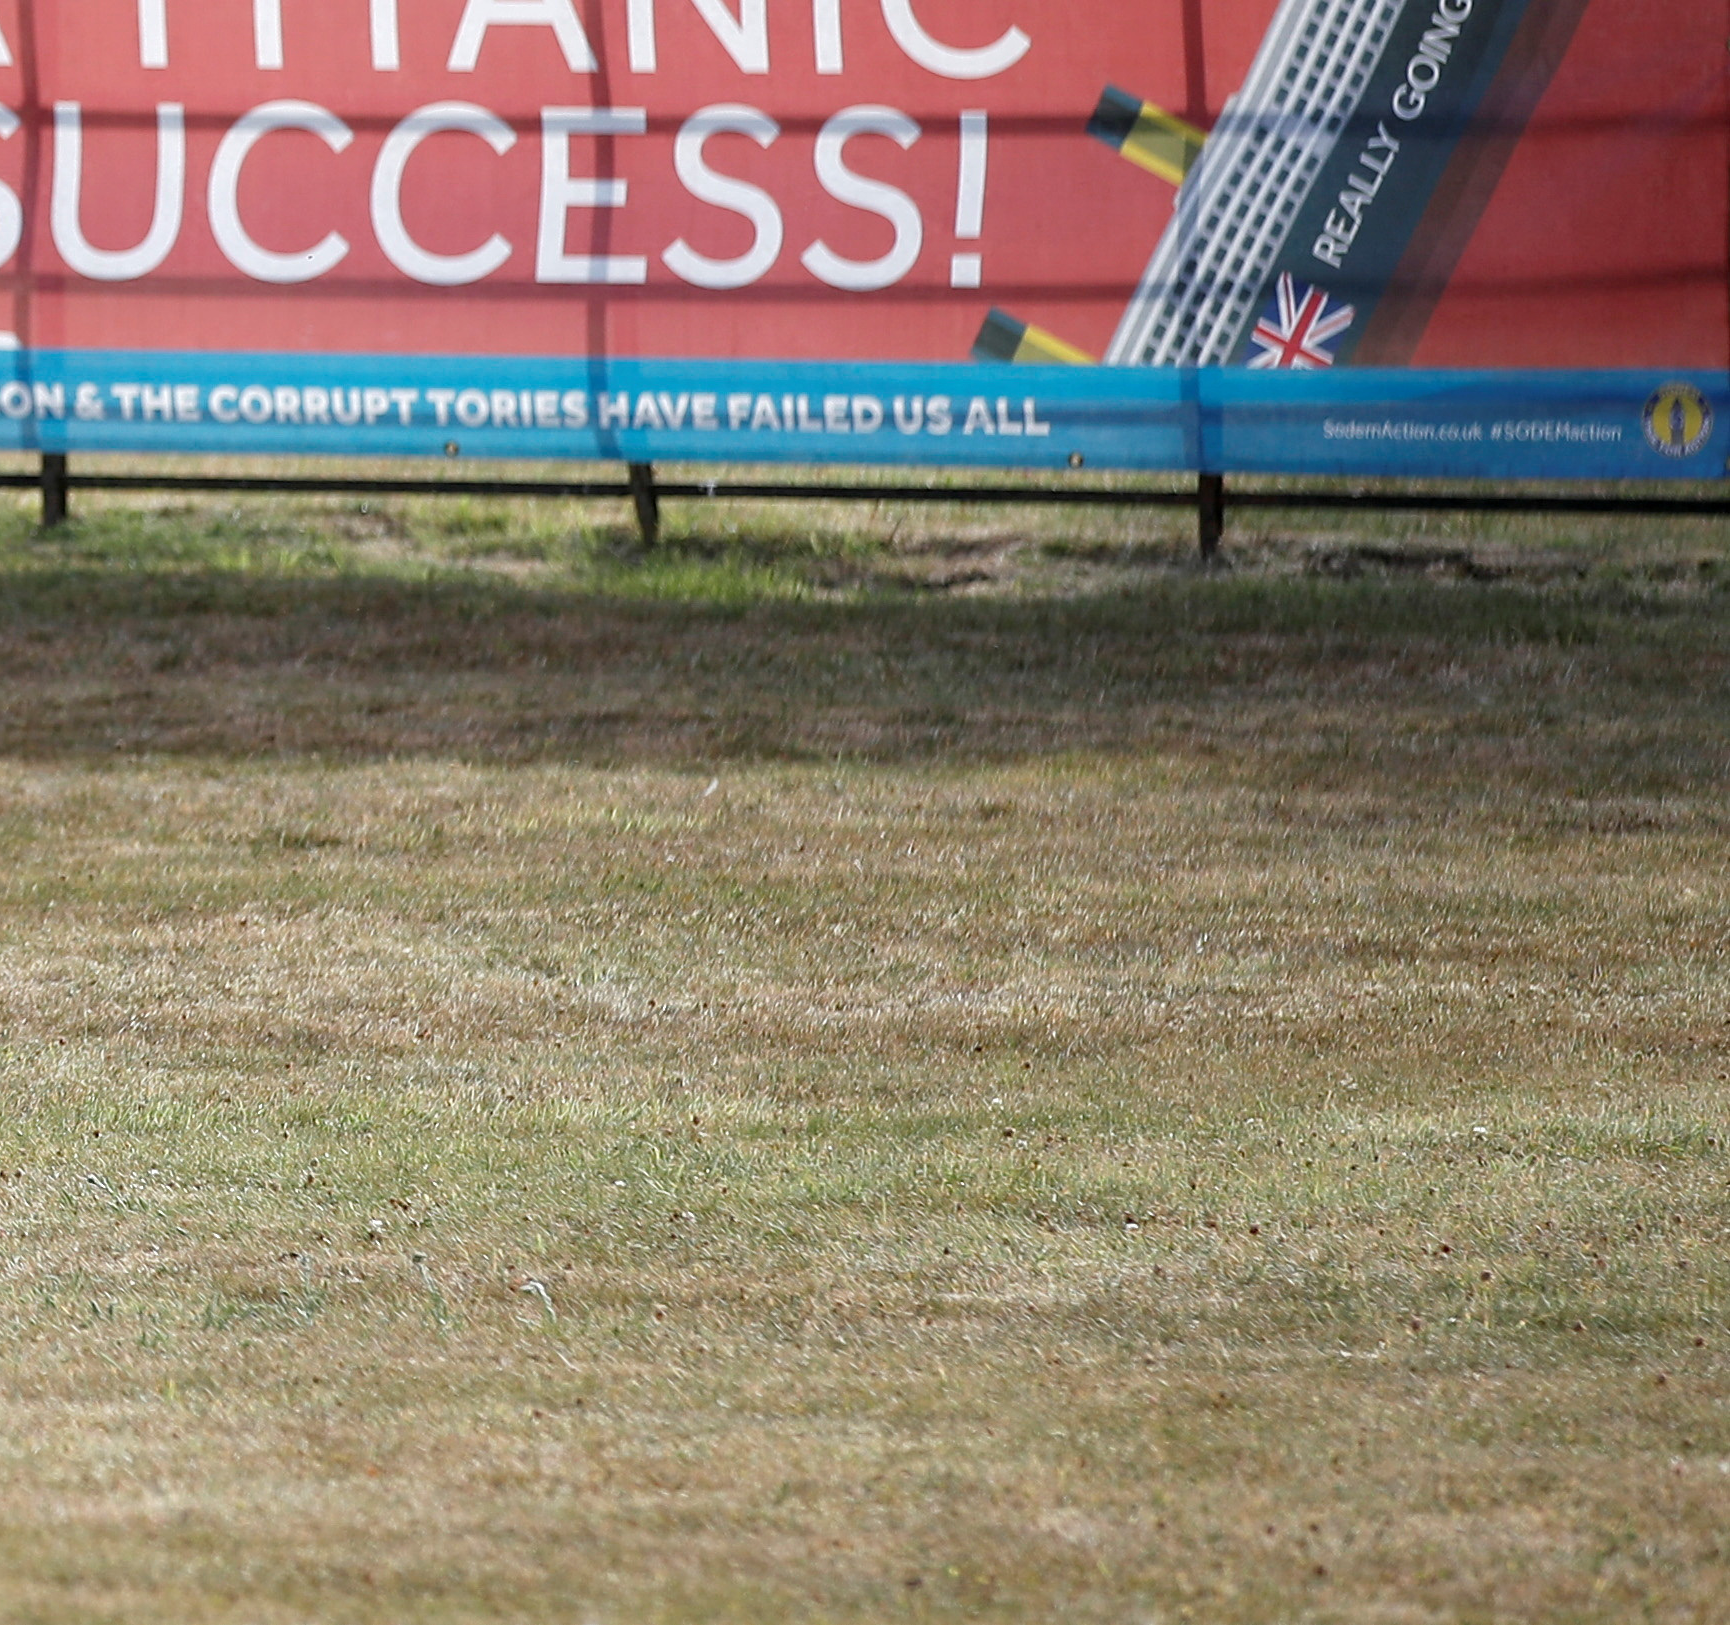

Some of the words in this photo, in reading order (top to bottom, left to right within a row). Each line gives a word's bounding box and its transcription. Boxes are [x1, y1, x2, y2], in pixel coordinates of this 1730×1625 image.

[1311, 120, 1400, 269] REALLY
[75, 383, 104, 419] &
[111, 384, 200, 421] THE
[208, 385, 419, 425] CORRUPT
[426, 388, 588, 428] TORIES
[599, 391, 719, 431] HAVE
[727, 393, 885, 434] FAILED
[892, 395, 952, 436] US
[963, 397, 1051, 437] ALL
